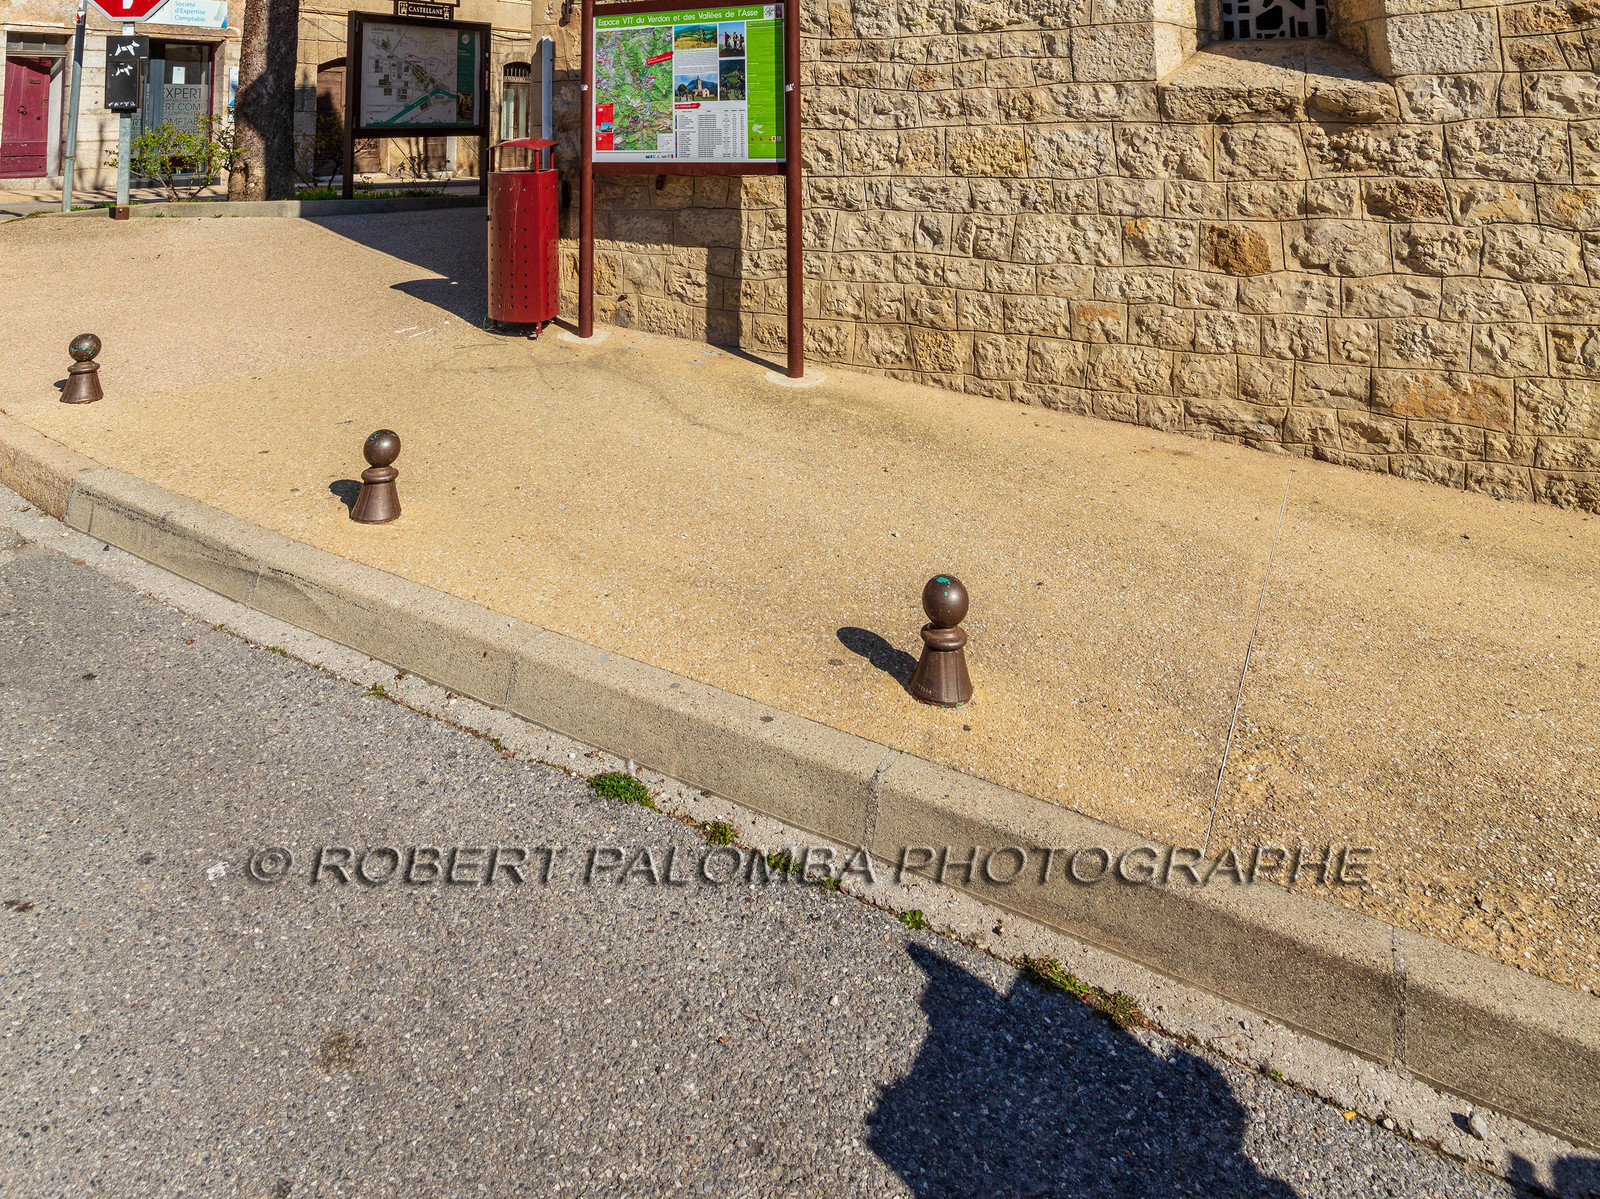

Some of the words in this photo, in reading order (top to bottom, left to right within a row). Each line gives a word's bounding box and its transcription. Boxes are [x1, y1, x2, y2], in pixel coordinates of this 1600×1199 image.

[408, 5, 443, 15] CASTELLANE
[598, 19, 620, 27] Espace
[622, 16, 634, 25] VTT
[635, 16, 645, 24] du
[647, 14, 671, 23] Verdon
[672, 13, 681, 21] et
[682, 12, 696, 21] des
[698, 10, 722, 19] Vallées
[724, 10, 735, 18] de
[737, 8, 759, 17] l'Asse
[164, 87, 202, 99] XPERT
